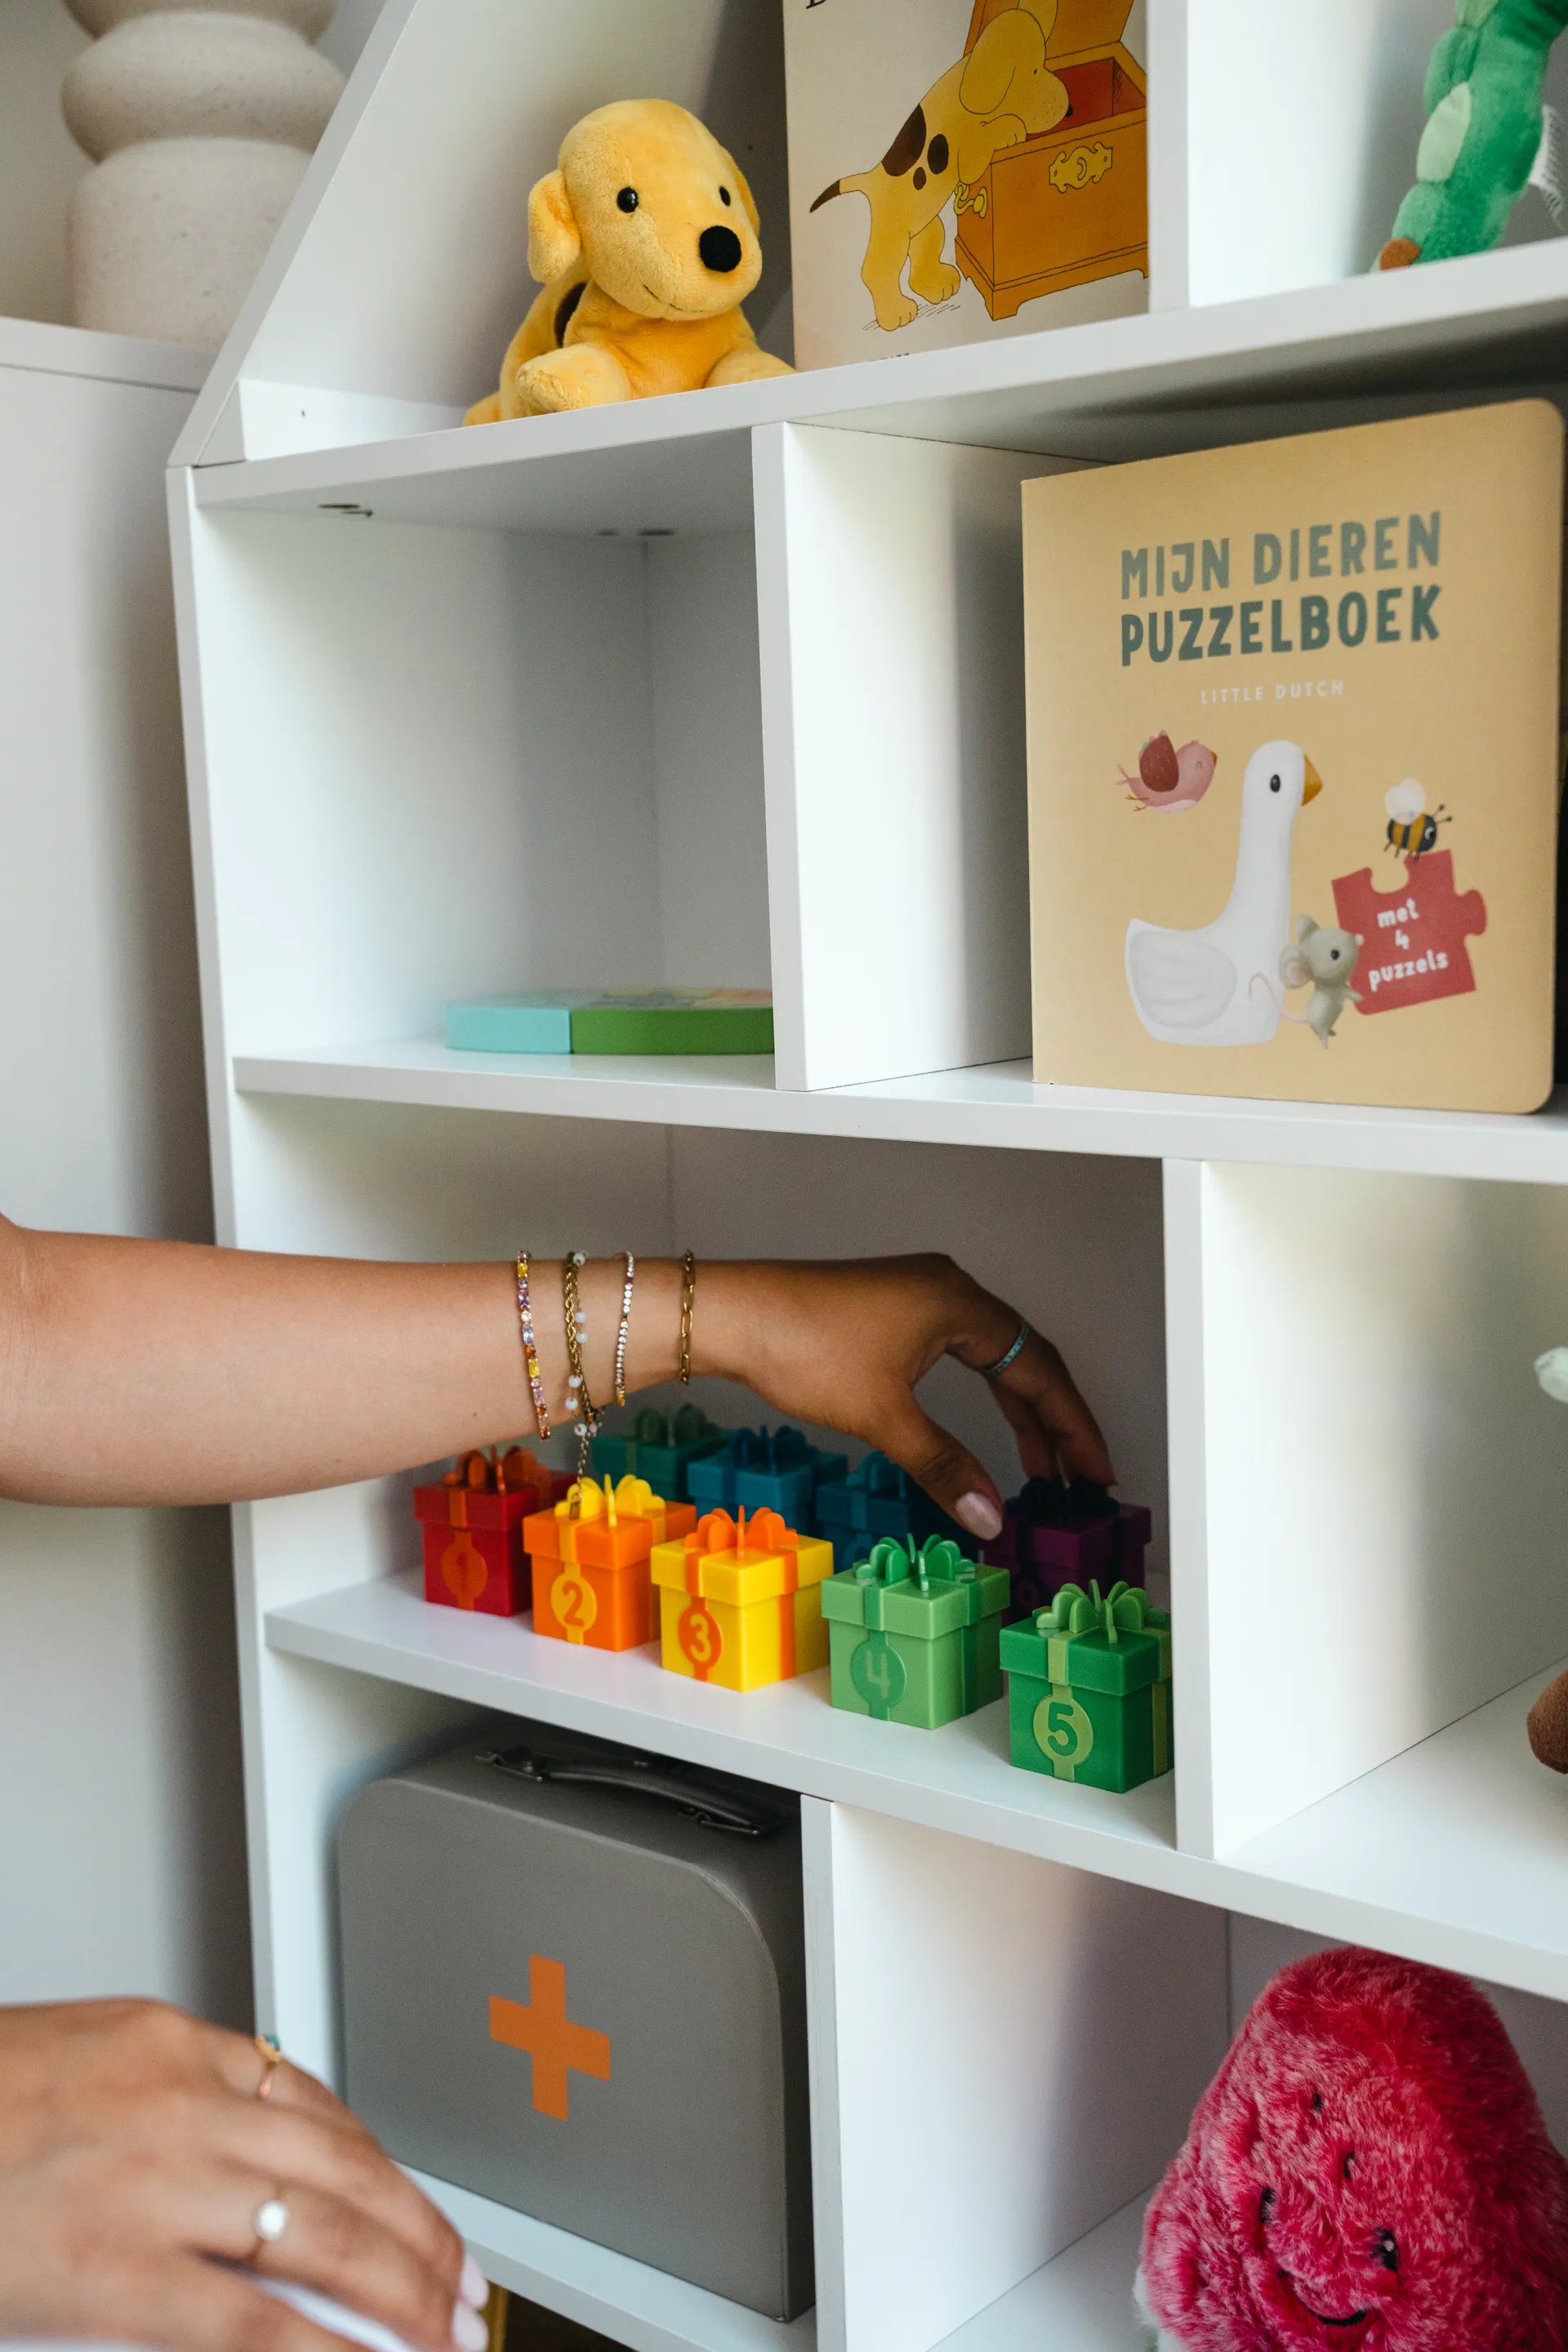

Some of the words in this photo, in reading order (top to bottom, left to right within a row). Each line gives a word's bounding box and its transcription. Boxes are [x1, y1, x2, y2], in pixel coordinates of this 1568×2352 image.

[1121, 537, 1230, 600] MIJN
[1253, 511, 1441, 586] DIEREN
[1121, 583, 1441, 667] PUZZELBOEK
[1200, 685, 1264, 705] LITTLE
[1276, 679, 1344, 701] DUTCH
[1377, 898, 1419, 928] met
[1394, 929, 1410, 950] 4
[1368, 949, 1449, 993] puzzels
[456, 1551, 469, 1592] 1
[562, 1580, 585, 1627] 2
[690, 1614, 712, 1663] 3
[866, 1650, 891, 1699] 4
[1047, 1701, 1079, 1757] 5
